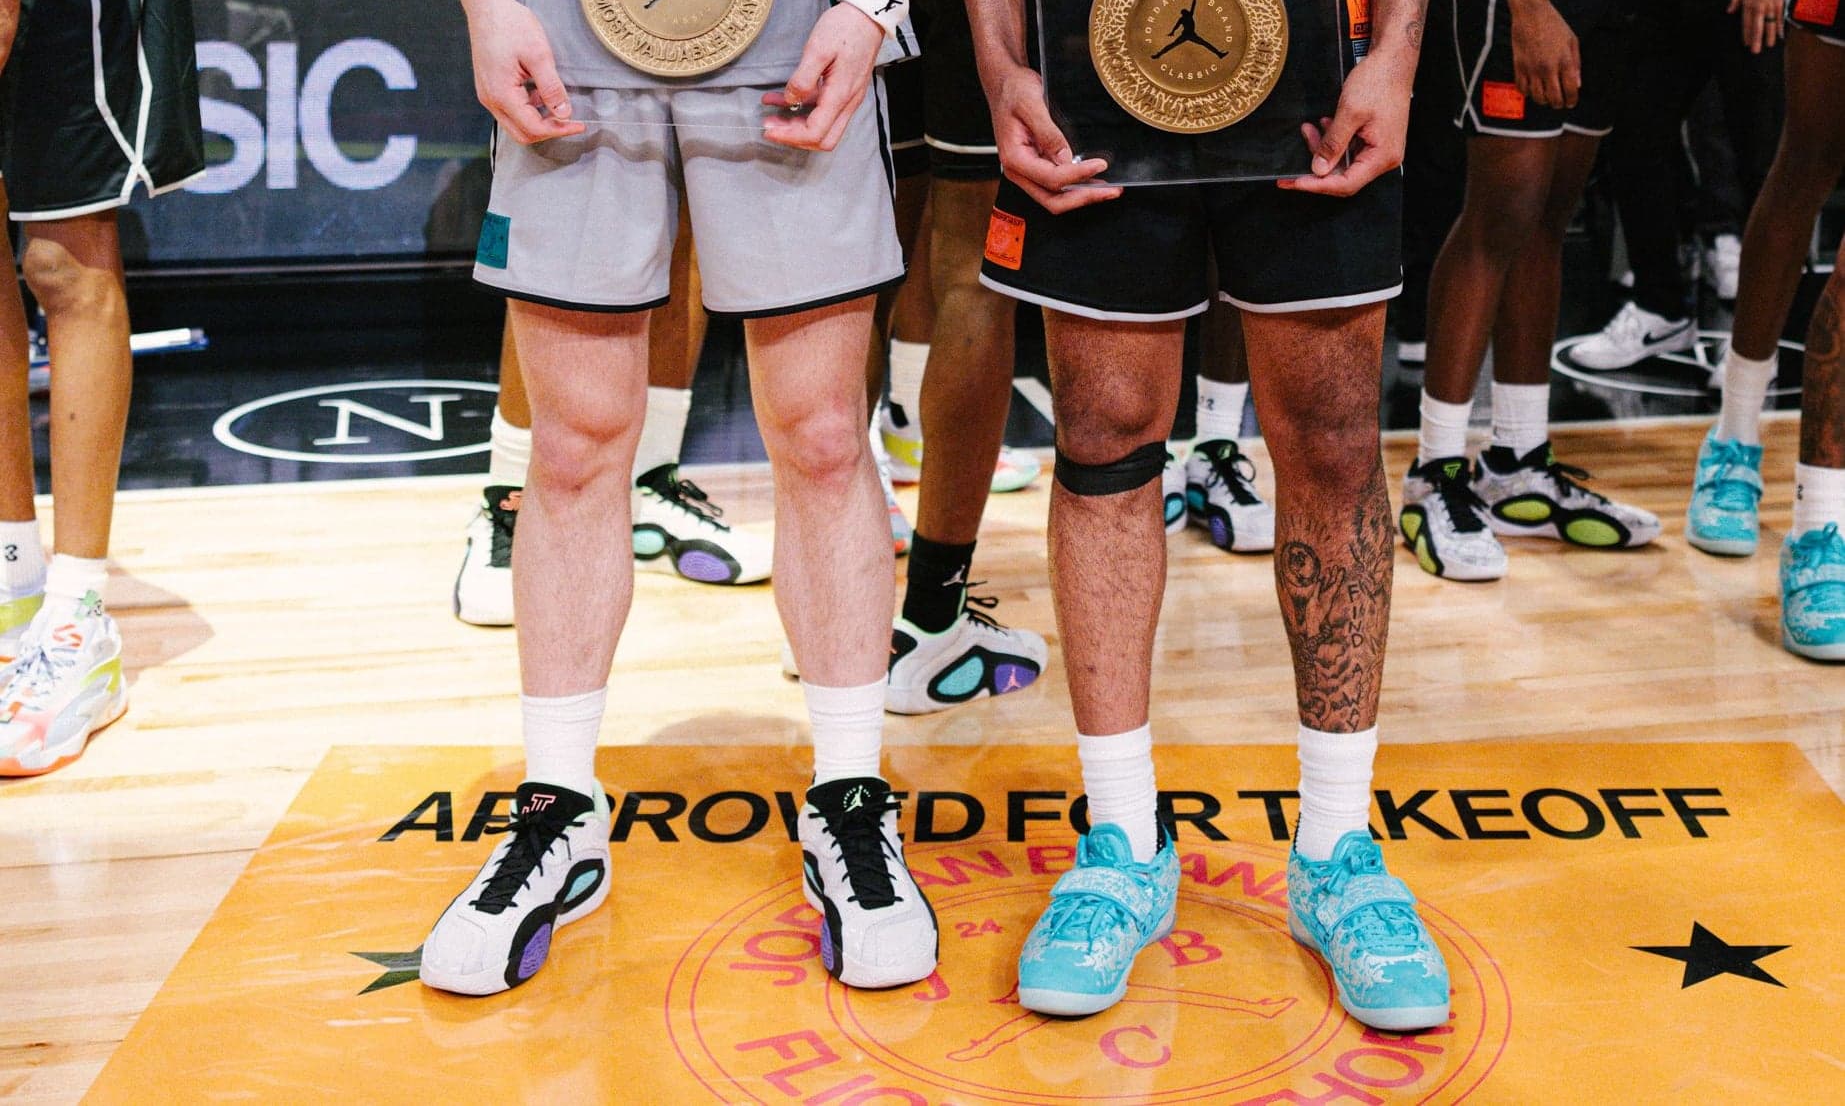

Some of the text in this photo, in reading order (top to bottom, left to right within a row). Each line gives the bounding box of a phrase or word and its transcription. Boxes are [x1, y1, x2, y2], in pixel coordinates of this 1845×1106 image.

[1207, 0, 1233, 43] BRAND
[1160, 63, 1218, 80] CLASSIC
[313, 394, 462, 445] N
[1237, 787, 1732, 842] TKEOFF
[1099, 1024, 1172, 1069] C
